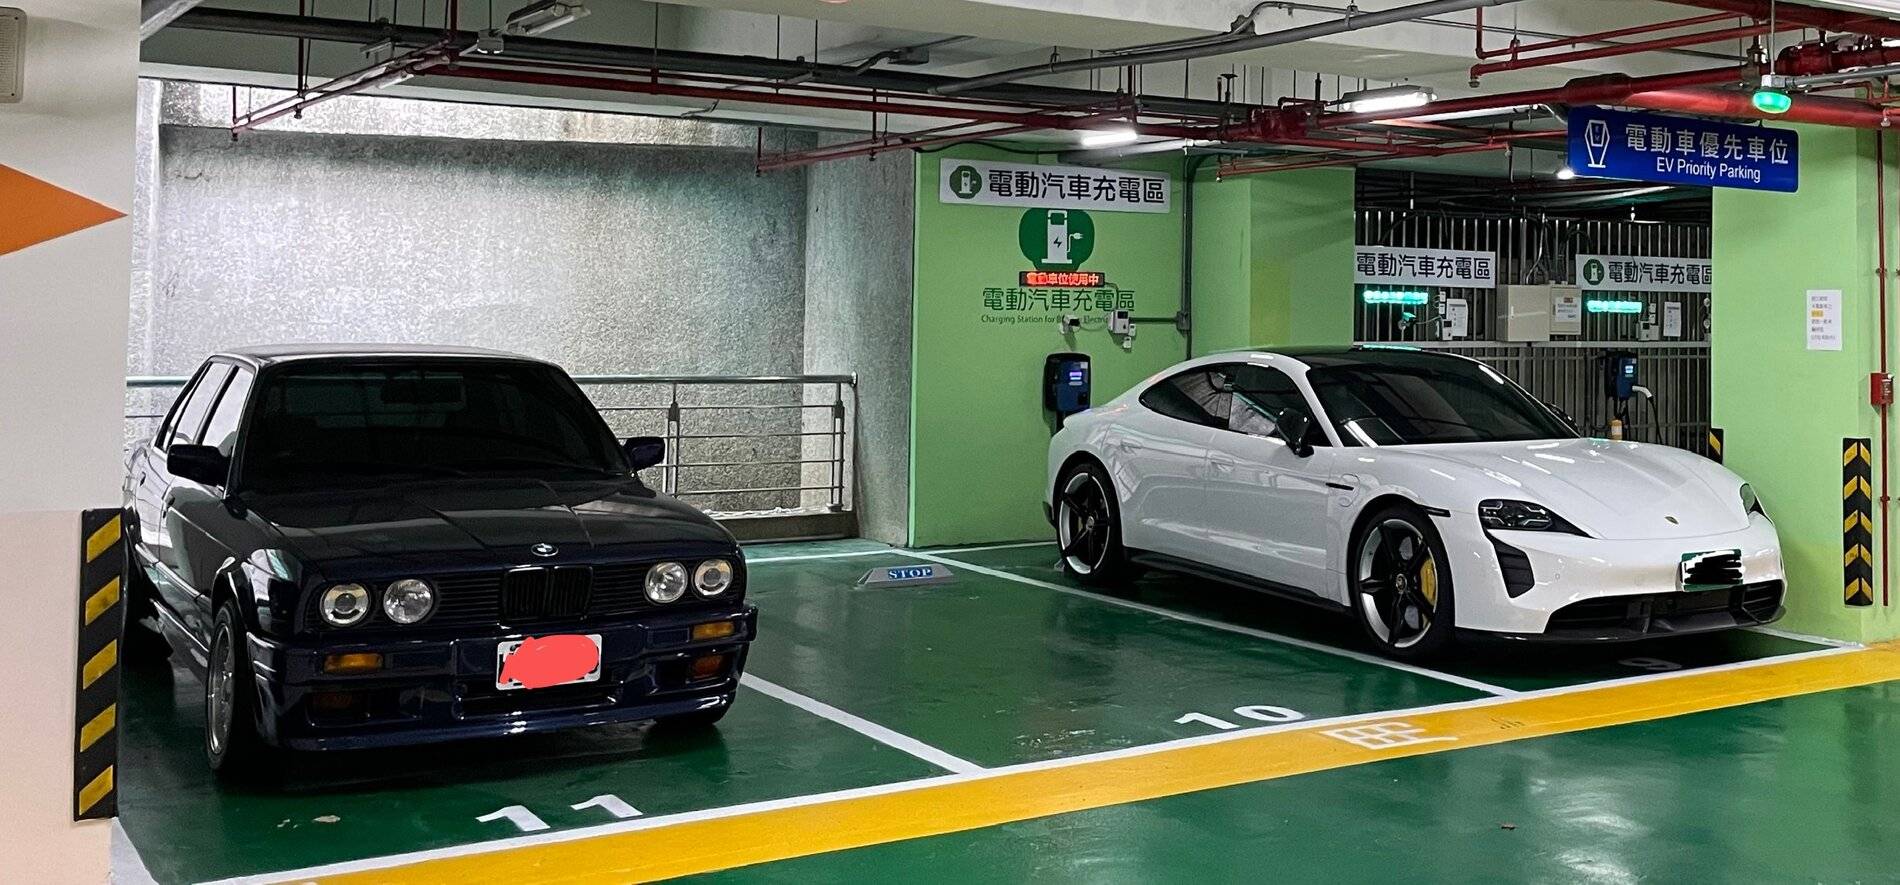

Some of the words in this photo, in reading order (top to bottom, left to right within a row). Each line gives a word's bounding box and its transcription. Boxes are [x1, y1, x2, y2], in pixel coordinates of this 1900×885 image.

[1625, 123, 1789, 165] 電動車優先車位
[1656, 156, 1675, 172] EV
[1677, 160, 1717, 180] Priority
[1719, 163, 1761, 183] Parking
[988, 169, 1165, 203] 電動汽車充電區
[1356, 252, 1491, 280] 電動汽車充電區
[982, 287, 1135, 312] 電動汽車充電區
[981, 314, 1016, 325] Charging
[1017, 315, 1043, 323] Station
[1044, 315, 1055, 323] for
[888, 567, 932, 579] STOP
[1174, 705, 1305, 730] 10
[475, 794, 643, 832] 11
